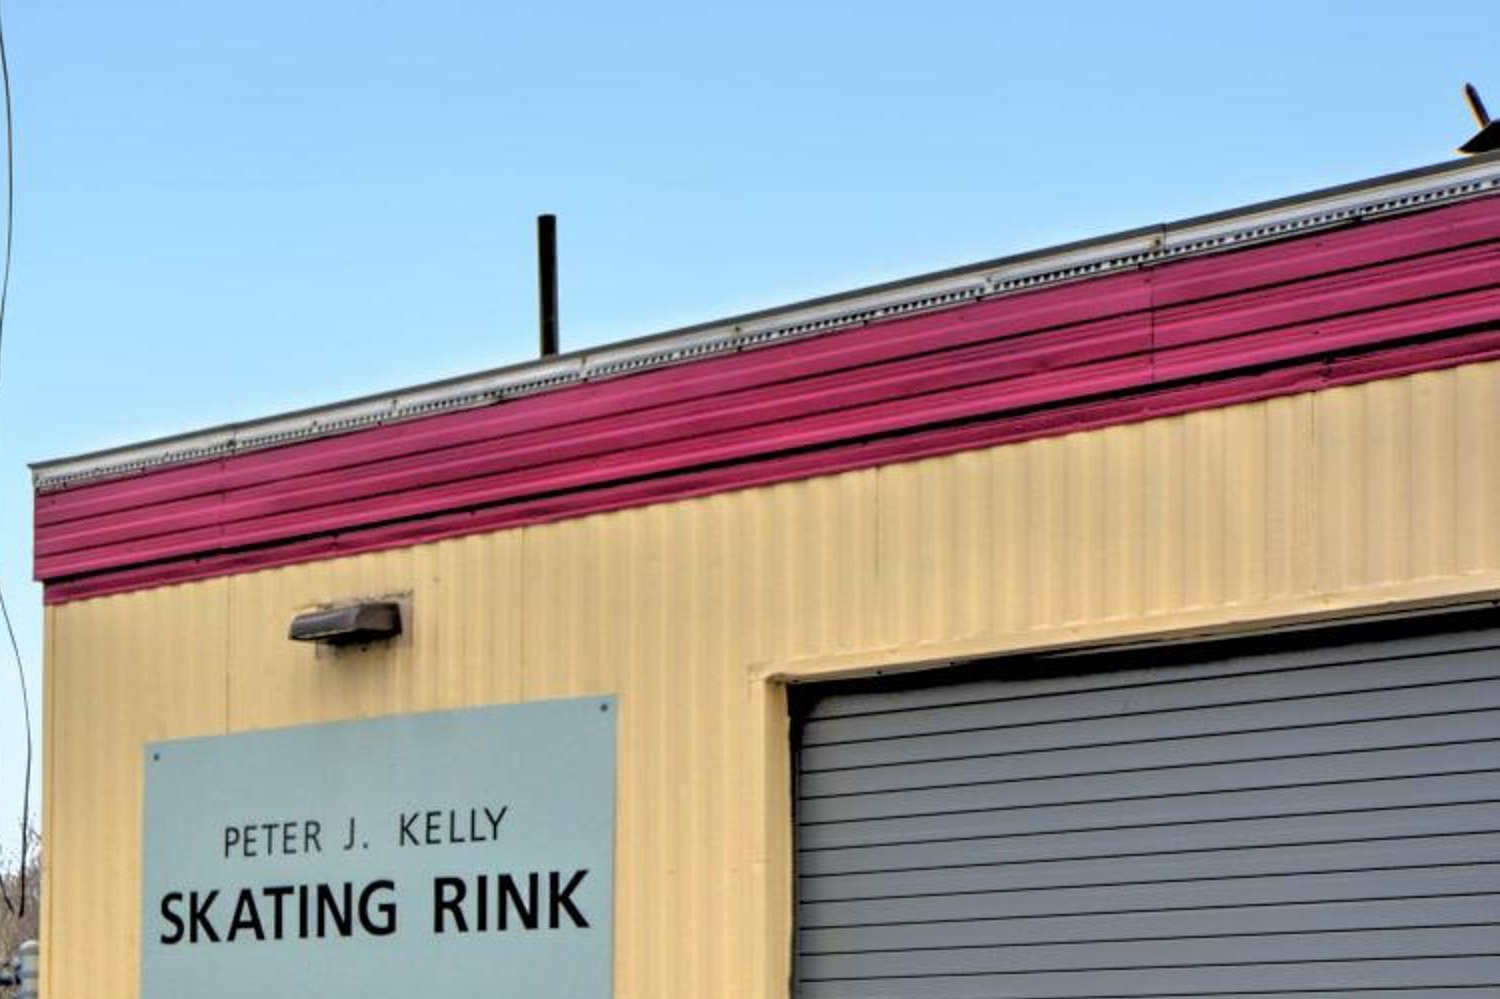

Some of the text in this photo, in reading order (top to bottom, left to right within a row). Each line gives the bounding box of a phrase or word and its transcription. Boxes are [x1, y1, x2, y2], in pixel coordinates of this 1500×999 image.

[224, 807, 508, 858] PETER J. KELLY
[160, 869, 590, 945] SKATING RINK
